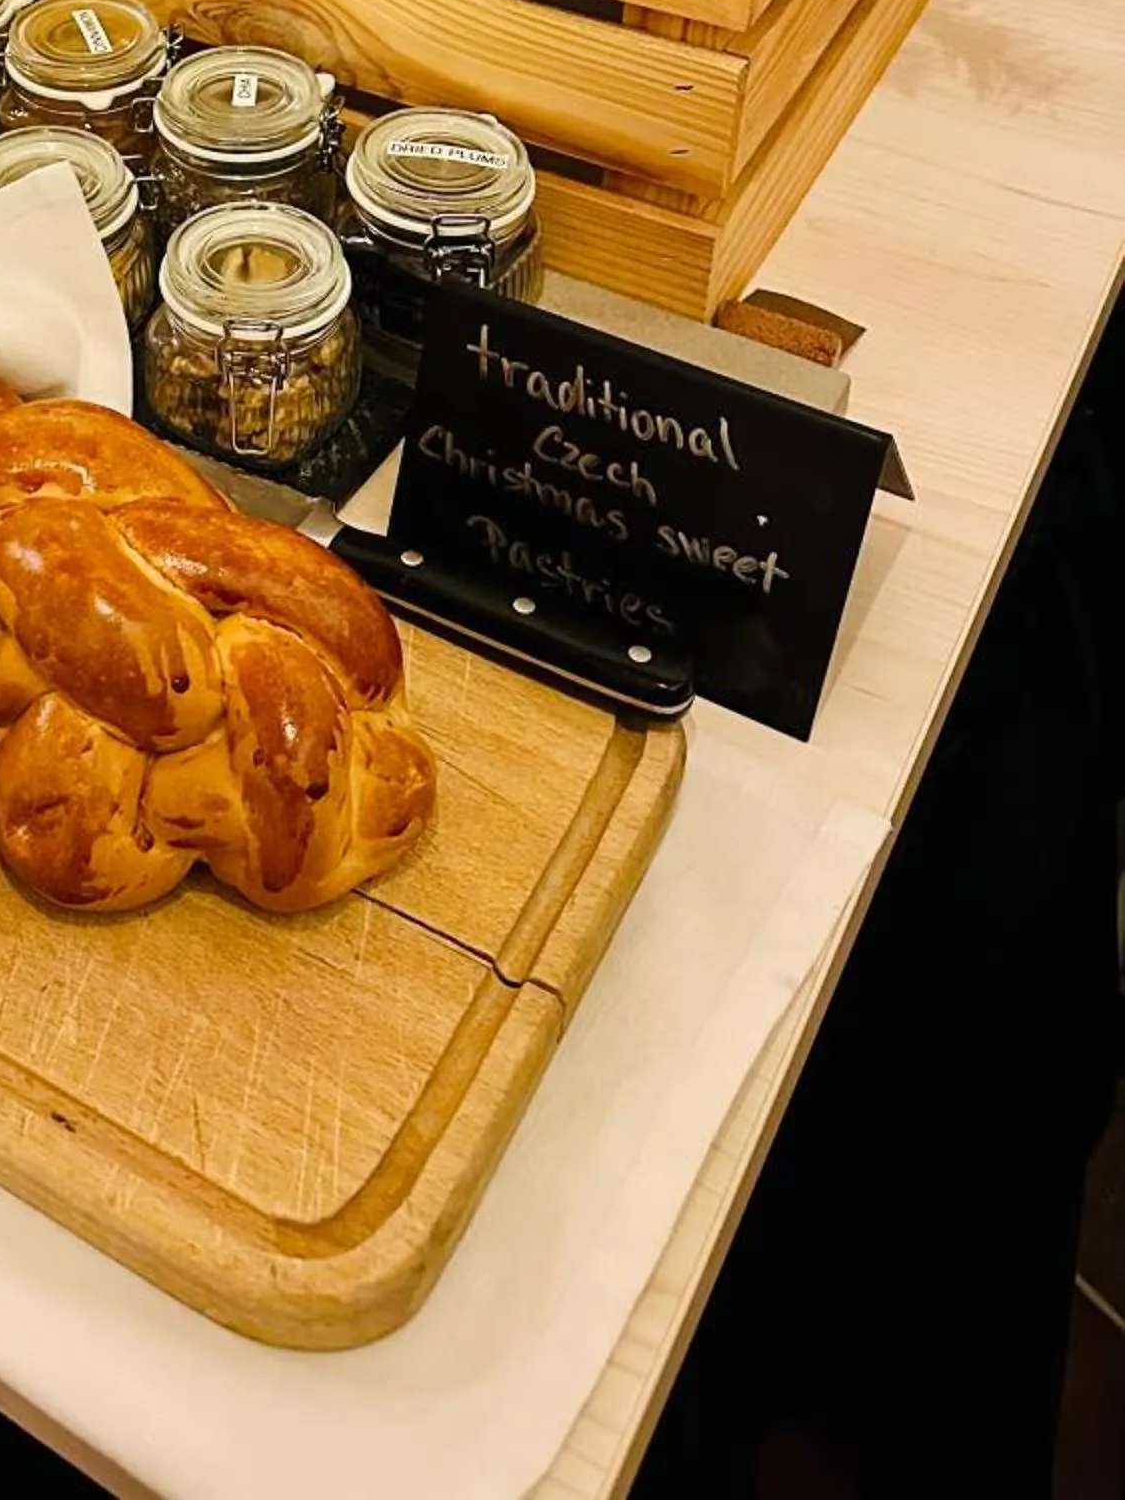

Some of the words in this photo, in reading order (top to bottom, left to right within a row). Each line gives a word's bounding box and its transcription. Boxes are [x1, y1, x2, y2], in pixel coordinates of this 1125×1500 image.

[390, 142, 443, 156] DRIED
[448, 148, 506, 166] PLUMS
[466, 322, 741, 471] traditional
[417, 423, 630, 542] Christmas
[655, 523, 791, 596] sweet
[532, 424, 658, 507] Czech
